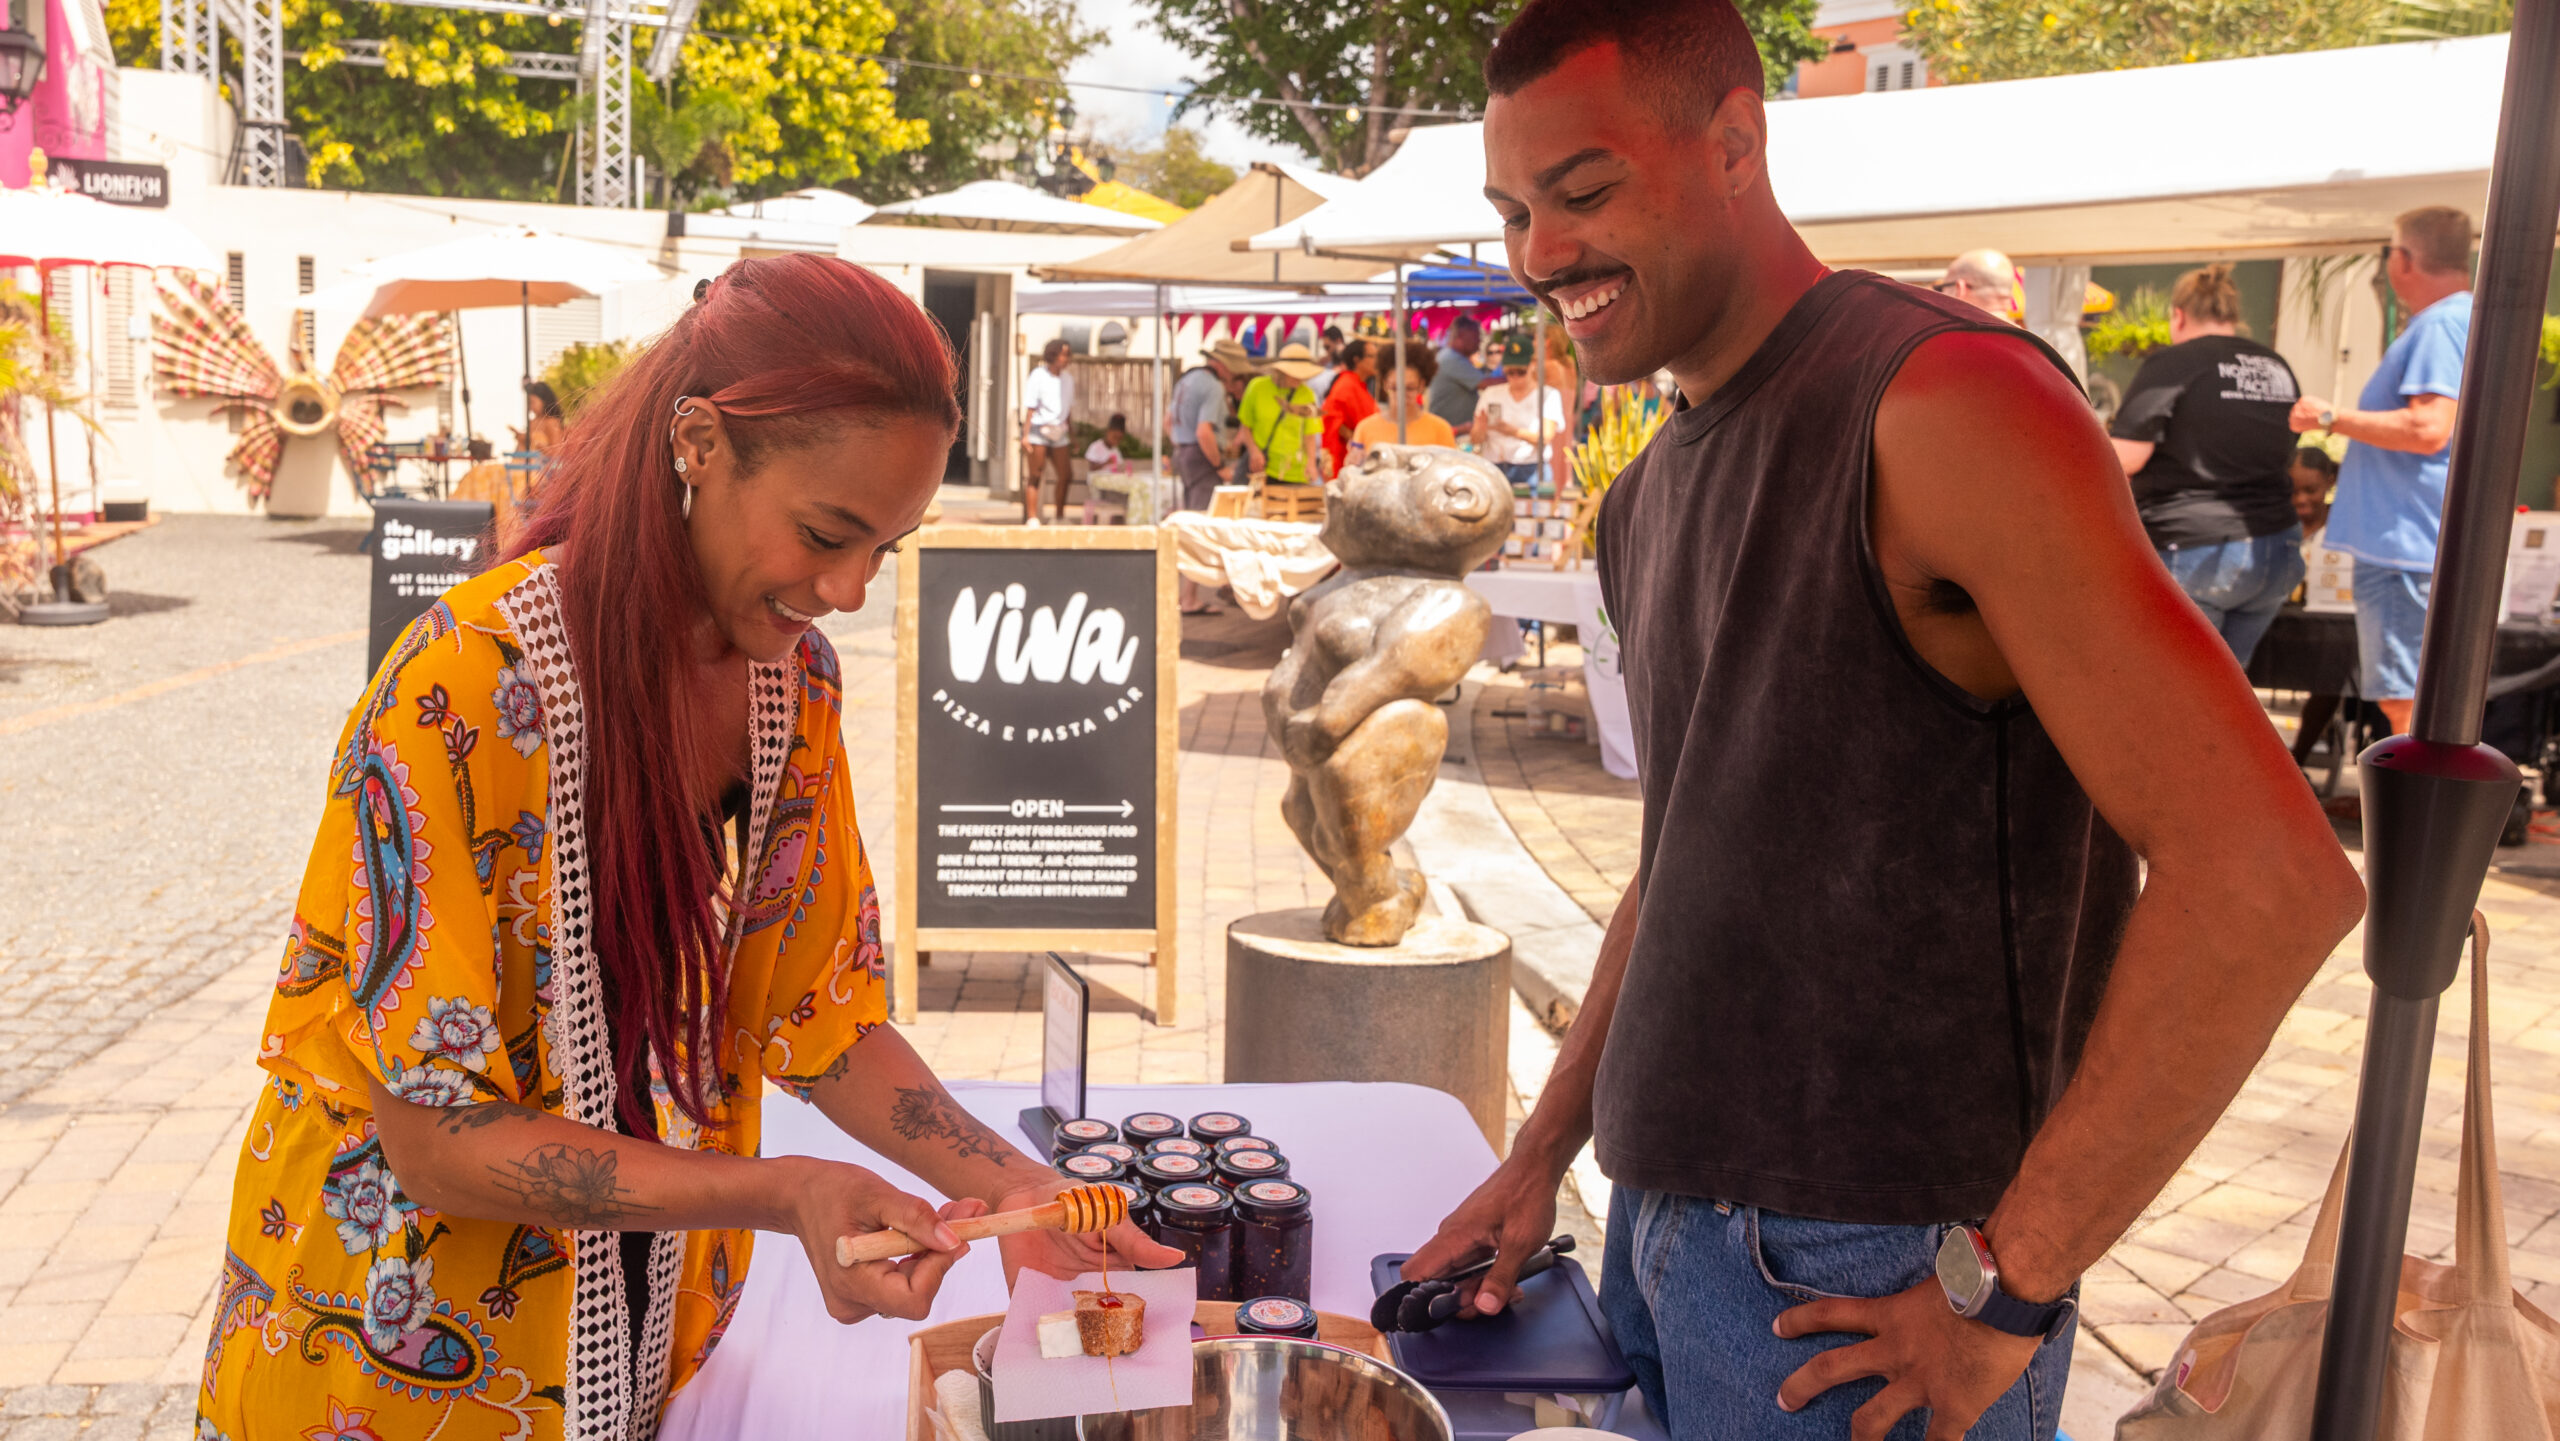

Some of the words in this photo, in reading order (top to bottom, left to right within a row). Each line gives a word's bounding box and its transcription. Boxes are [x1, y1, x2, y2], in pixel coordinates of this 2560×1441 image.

[383, 518, 415, 537] the
[381, 529, 478, 561] gallery
[389, 573, 413, 585] ART
[932, 688, 990, 735] PIZZA
[1002, 725, 1015, 741] E
[1027, 718, 1097, 743] PASTA
[1103, 686, 1144, 722] BAR
[1011, 799, 1065, 818] OPEN
[937, 825, 958, 837] THE
[959, 825, 1004, 837] PERFECT
[1004, 825, 1032, 837] SPOT
[1032, 825, 1053, 837] FOR
[1054, 825, 1107, 837] DELICIOUS
[1108, 825, 1138, 837] FOOD
[969, 839, 993, 852] AND
[993, 839, 1002, 852] A
[1003, 839, 1030, 852] COOL
[937, 854, 963, 867] DINE
[963, 854, 976, 867] IN
[976, 854, 999, 867] OUR
[1045, 854, 1138, 867] AIR-CONDITIONED
[937, 869, 1005, 882] RESTAURANT
[1006, 869, 1022, 882] OR
[1022, 869, 1057, 882] RELAX
[1057, 869, 1070, 882] IN
[1070, 869, 1093, 882] OUR
[1094, 869, 1138, 882] SHADED
[947, 884, 997, 897] TROPICAL
[998, 884, 1042, 897] GARDEN
[1042, 884, 1071, 897] WITH
